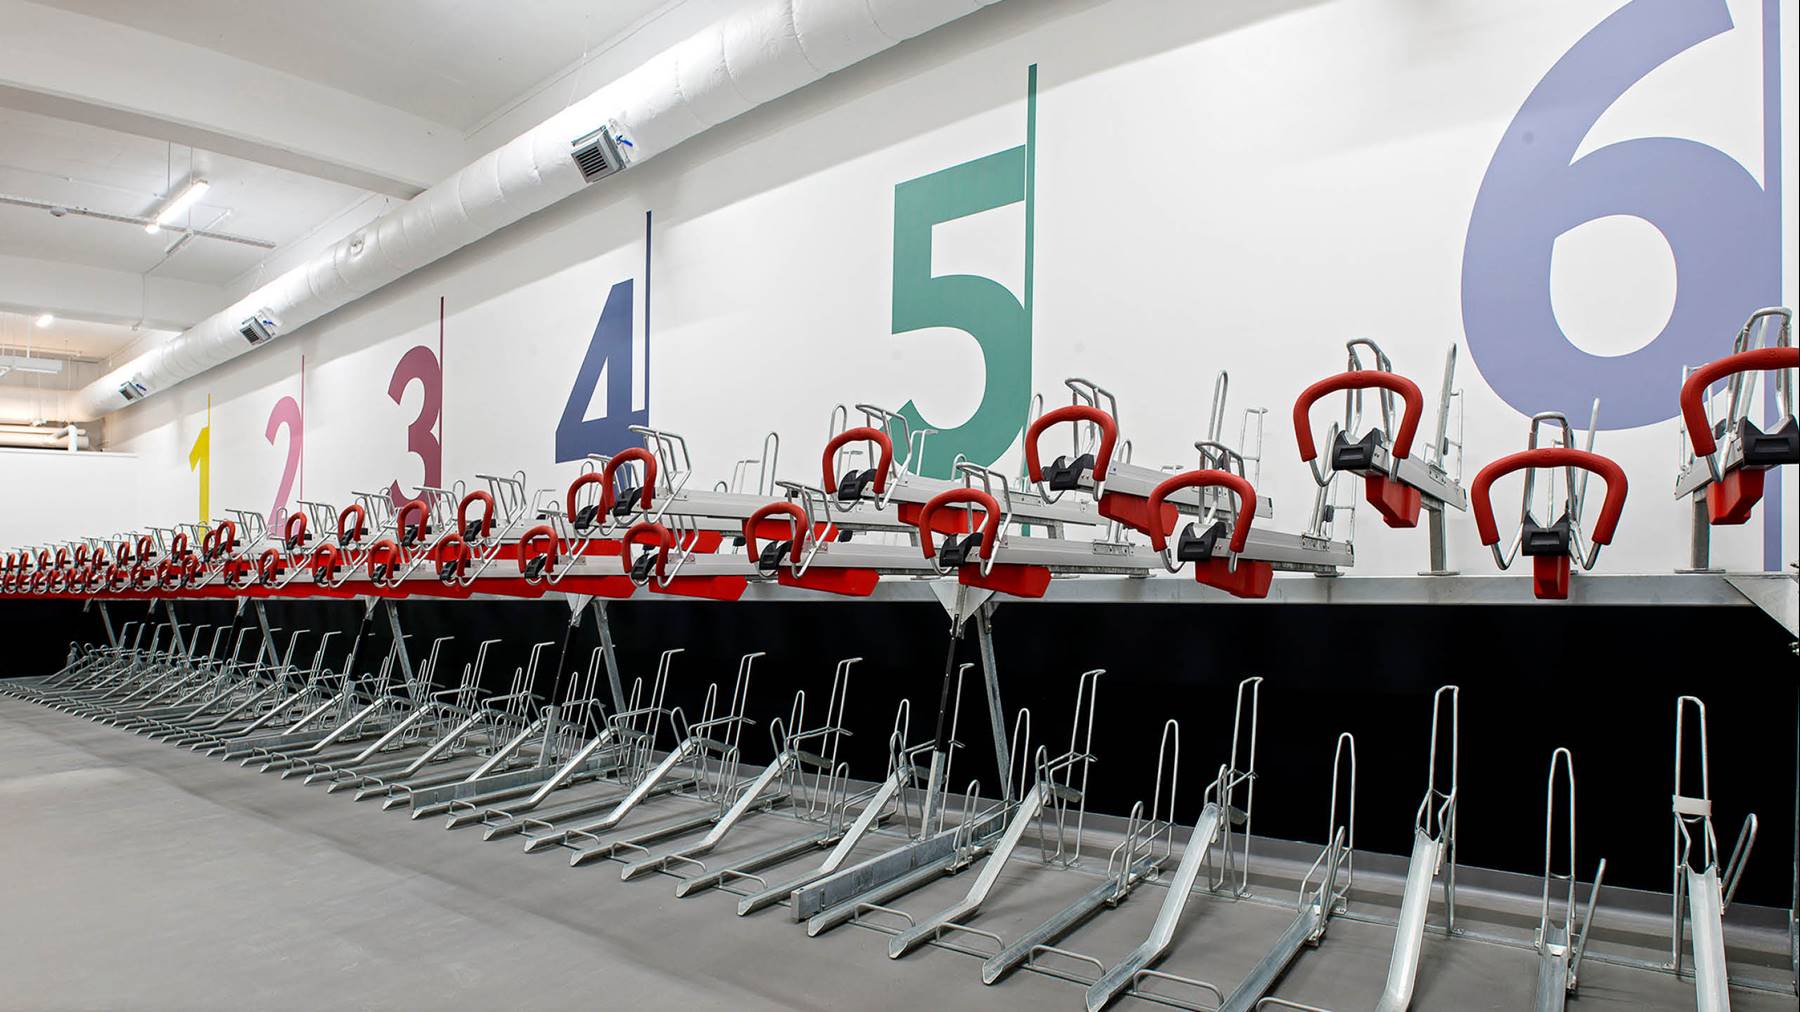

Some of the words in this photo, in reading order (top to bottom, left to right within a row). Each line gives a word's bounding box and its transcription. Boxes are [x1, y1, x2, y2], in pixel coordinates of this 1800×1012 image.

[880, 144, 1033, 480] 5
[1461, 0, 1782, 431] 6
[189, 426, 210, 545] 1
[265, 396, 303, 537] 2
[387, 345, 442, 525] 3
[555, 278, 649, 500] 4
